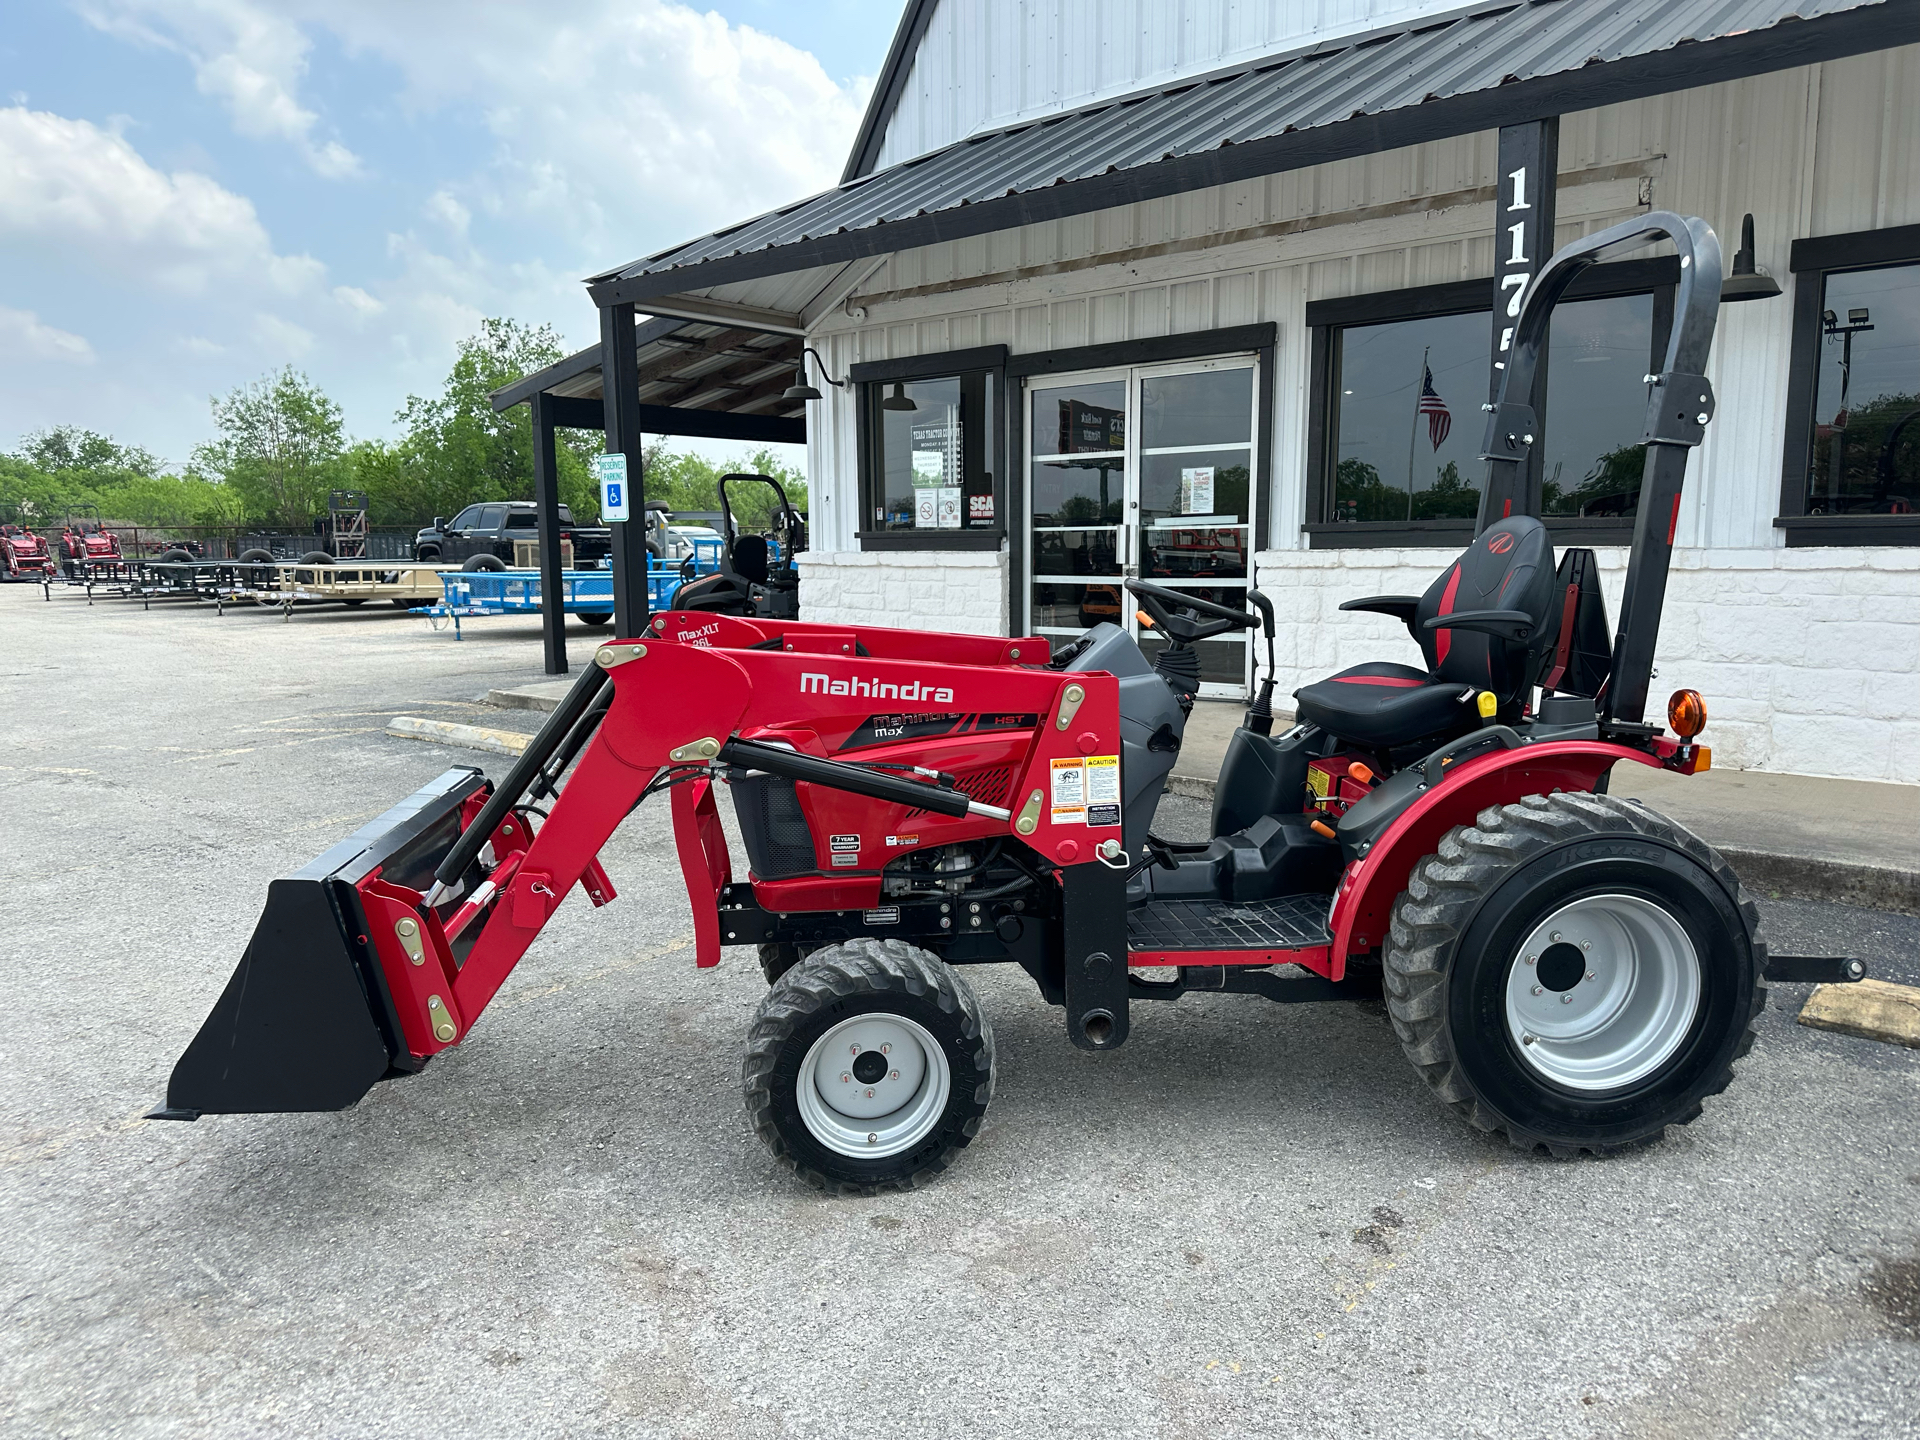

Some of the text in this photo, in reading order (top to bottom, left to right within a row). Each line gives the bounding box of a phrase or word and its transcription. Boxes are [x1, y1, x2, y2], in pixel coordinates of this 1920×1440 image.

[913, 430, 925, 440] TEXAS
[925, 429, 942, 439] TRACTOR
[601, 460, 624, 470] RESERVED
[603, 472, 624, 481] PARKING
[994, 715, 1025, 725] HST
